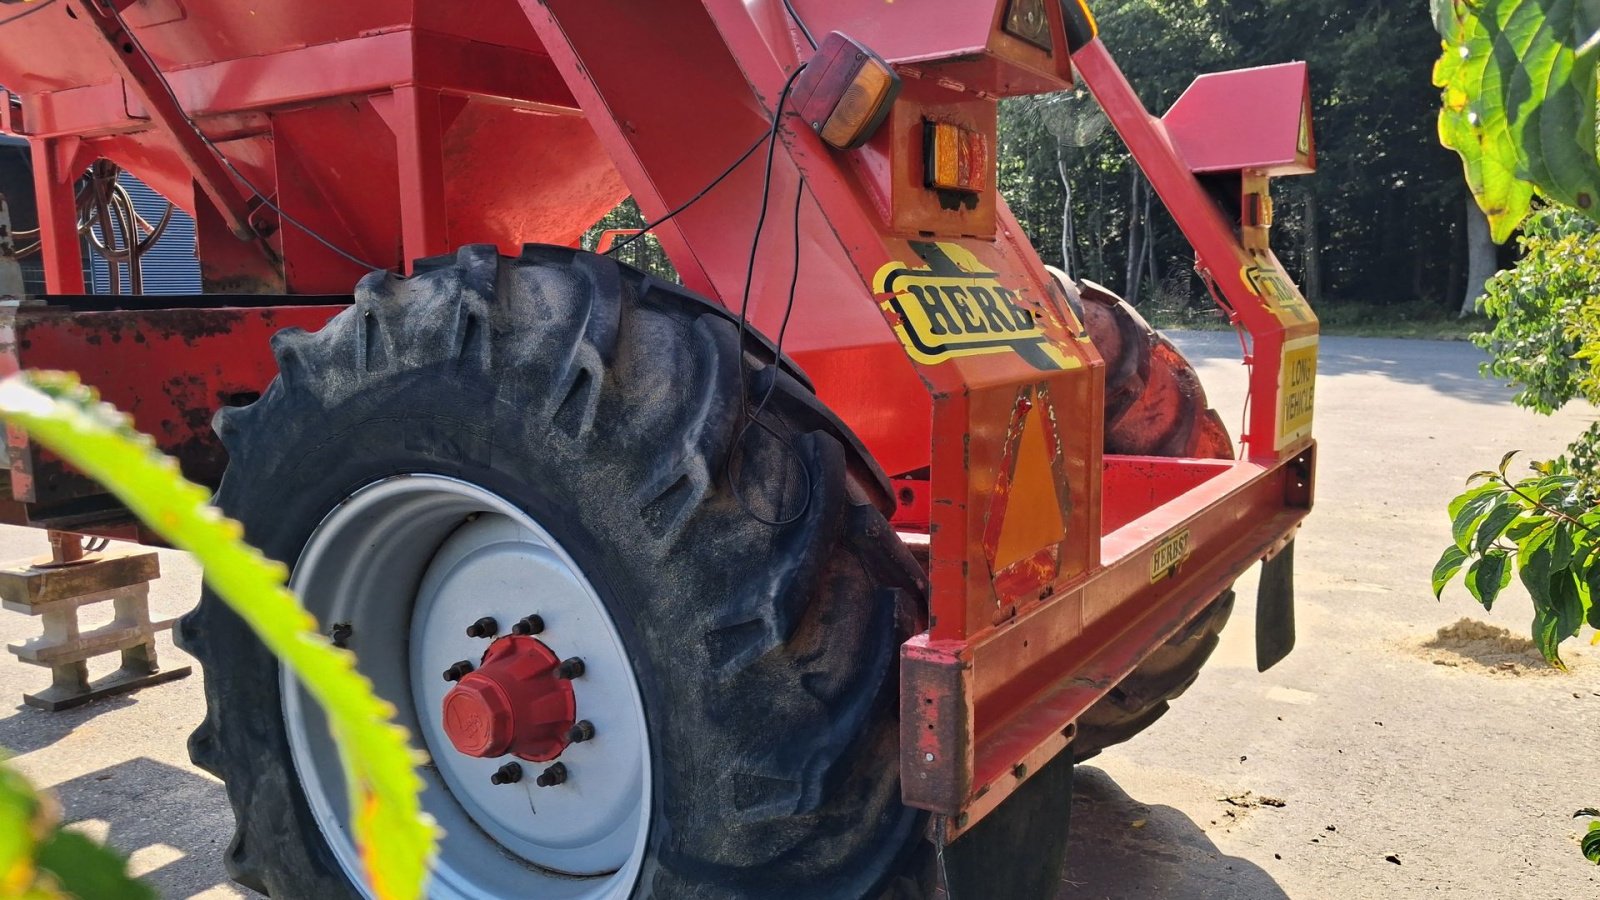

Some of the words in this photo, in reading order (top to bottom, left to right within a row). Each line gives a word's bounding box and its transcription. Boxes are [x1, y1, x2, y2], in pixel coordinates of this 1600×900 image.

[907, 284, 1036, 335] HERB
[1291, 358, 1311, 387] LONG
[1285, 386, 1313, 421] VEHICLE
